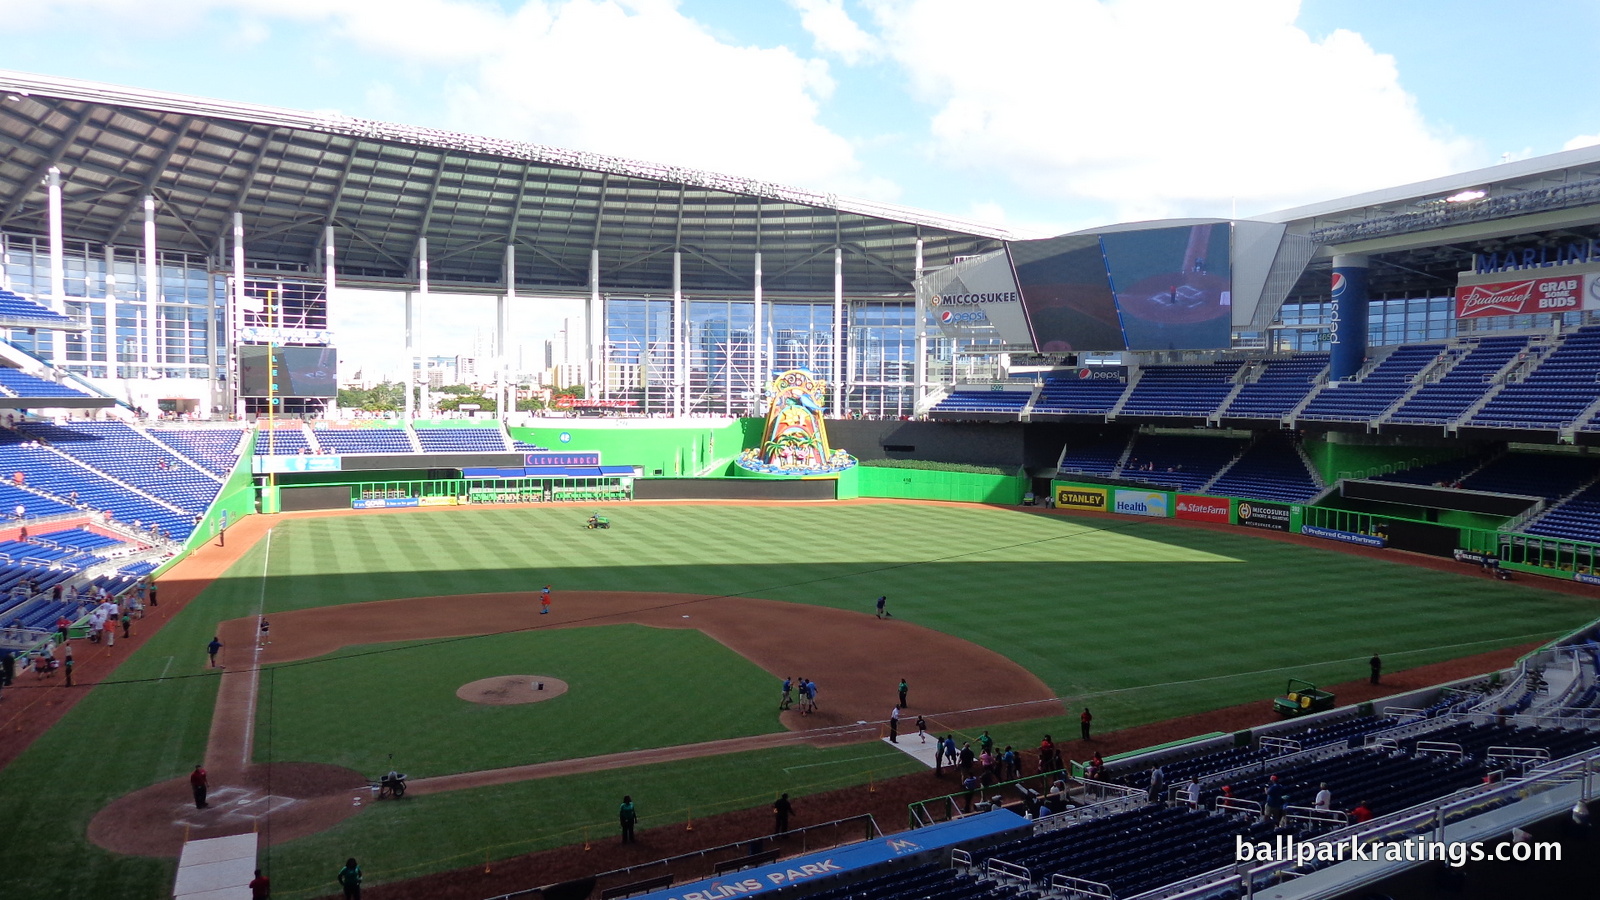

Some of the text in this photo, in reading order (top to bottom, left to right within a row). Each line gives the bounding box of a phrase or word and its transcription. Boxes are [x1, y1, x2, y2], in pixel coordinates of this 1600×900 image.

[1538, 280, 1577, 293] GRAB
[943, 292, 1016, 305] MICCOSUKEE
[1461, 291, 1531, 307] Budweiser
[1544, 290, 1570, 298] SOME
[1538, 296, 1577, 309] BUDS
[953, 310, 986, 322] pepsi
[1330, 300, 1341, 343] pepsi
[1093, 370, 1120, 380] pepsi
[527, 455, 597, 464] CLEVELANDER
[1062, 493, 1101, 504] STANLEY
[1117, 501, 1147, 512] Health
[1252, 507, 1289, 516] MICCOSUKEE
[1308, 528, 1336, 537] Preferred
[1351, 536, 1380, 545] Partners
[766, 859, 844, 885] PARK
